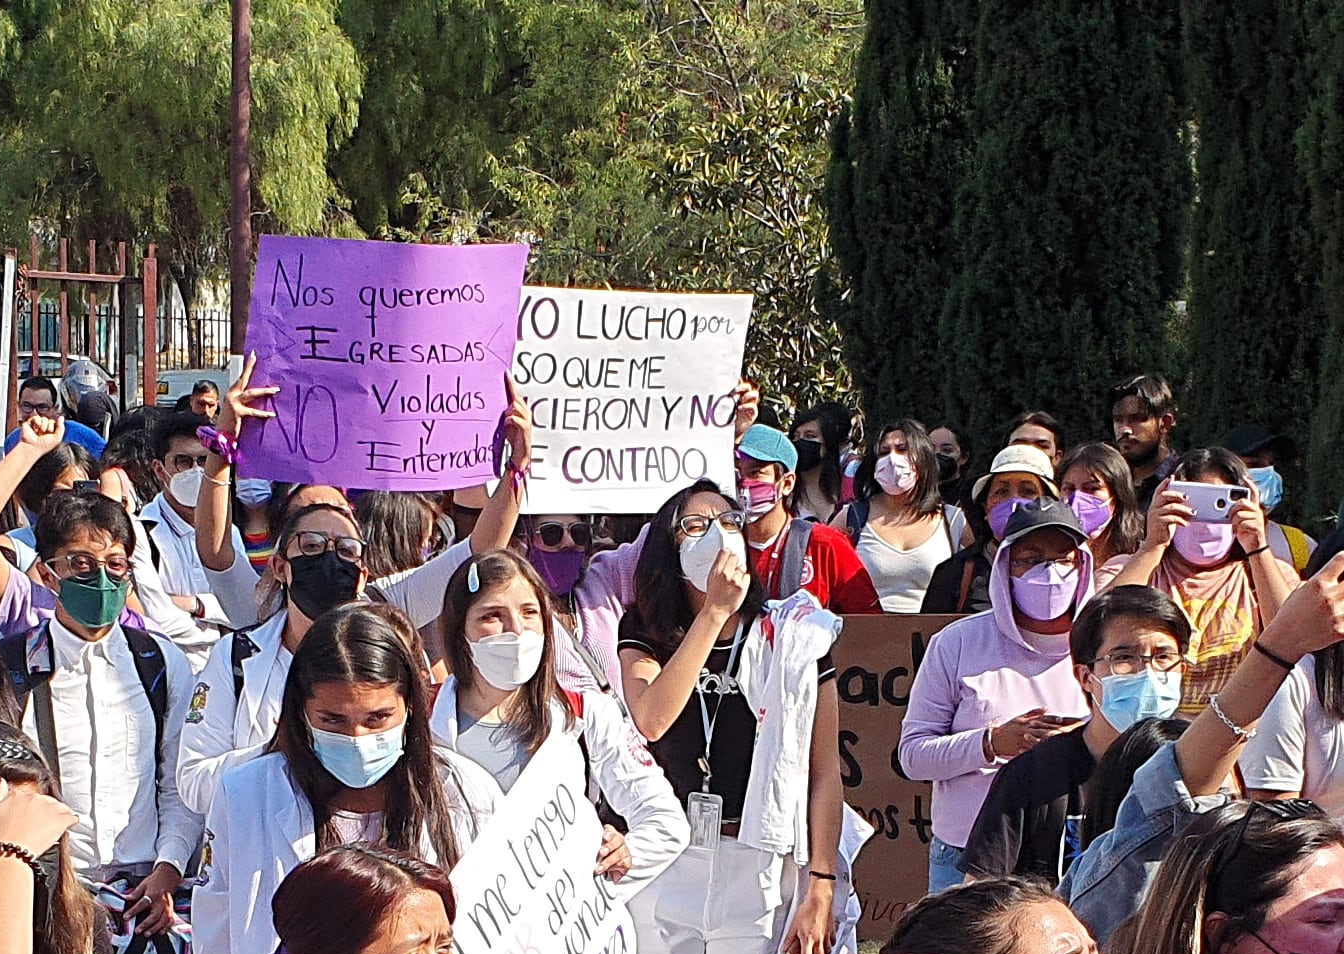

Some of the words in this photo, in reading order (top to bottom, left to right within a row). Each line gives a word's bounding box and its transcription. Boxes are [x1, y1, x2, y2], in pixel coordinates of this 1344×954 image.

[271, 253, 335, 308] Nos
[358, 283, 485, 338] queremos
[576, 299, 687, 341] LUCHO
[689, 314, 735, 342] por
[295, 325, 485, 365] EGRESADAS
[513, 351, 558, 386] SO
[562, 355, 625, 390] QUE
[628, 355, 666, 389] ME
[371, 374, 486, 415] Violadas
[662, 396, 684, 431] Y
[689, 394, 737, 430] NO
[259, 384, 339, 464] NO
[561, 445, 708, 484] CONTADO
[467, 873, 522, 950] me
